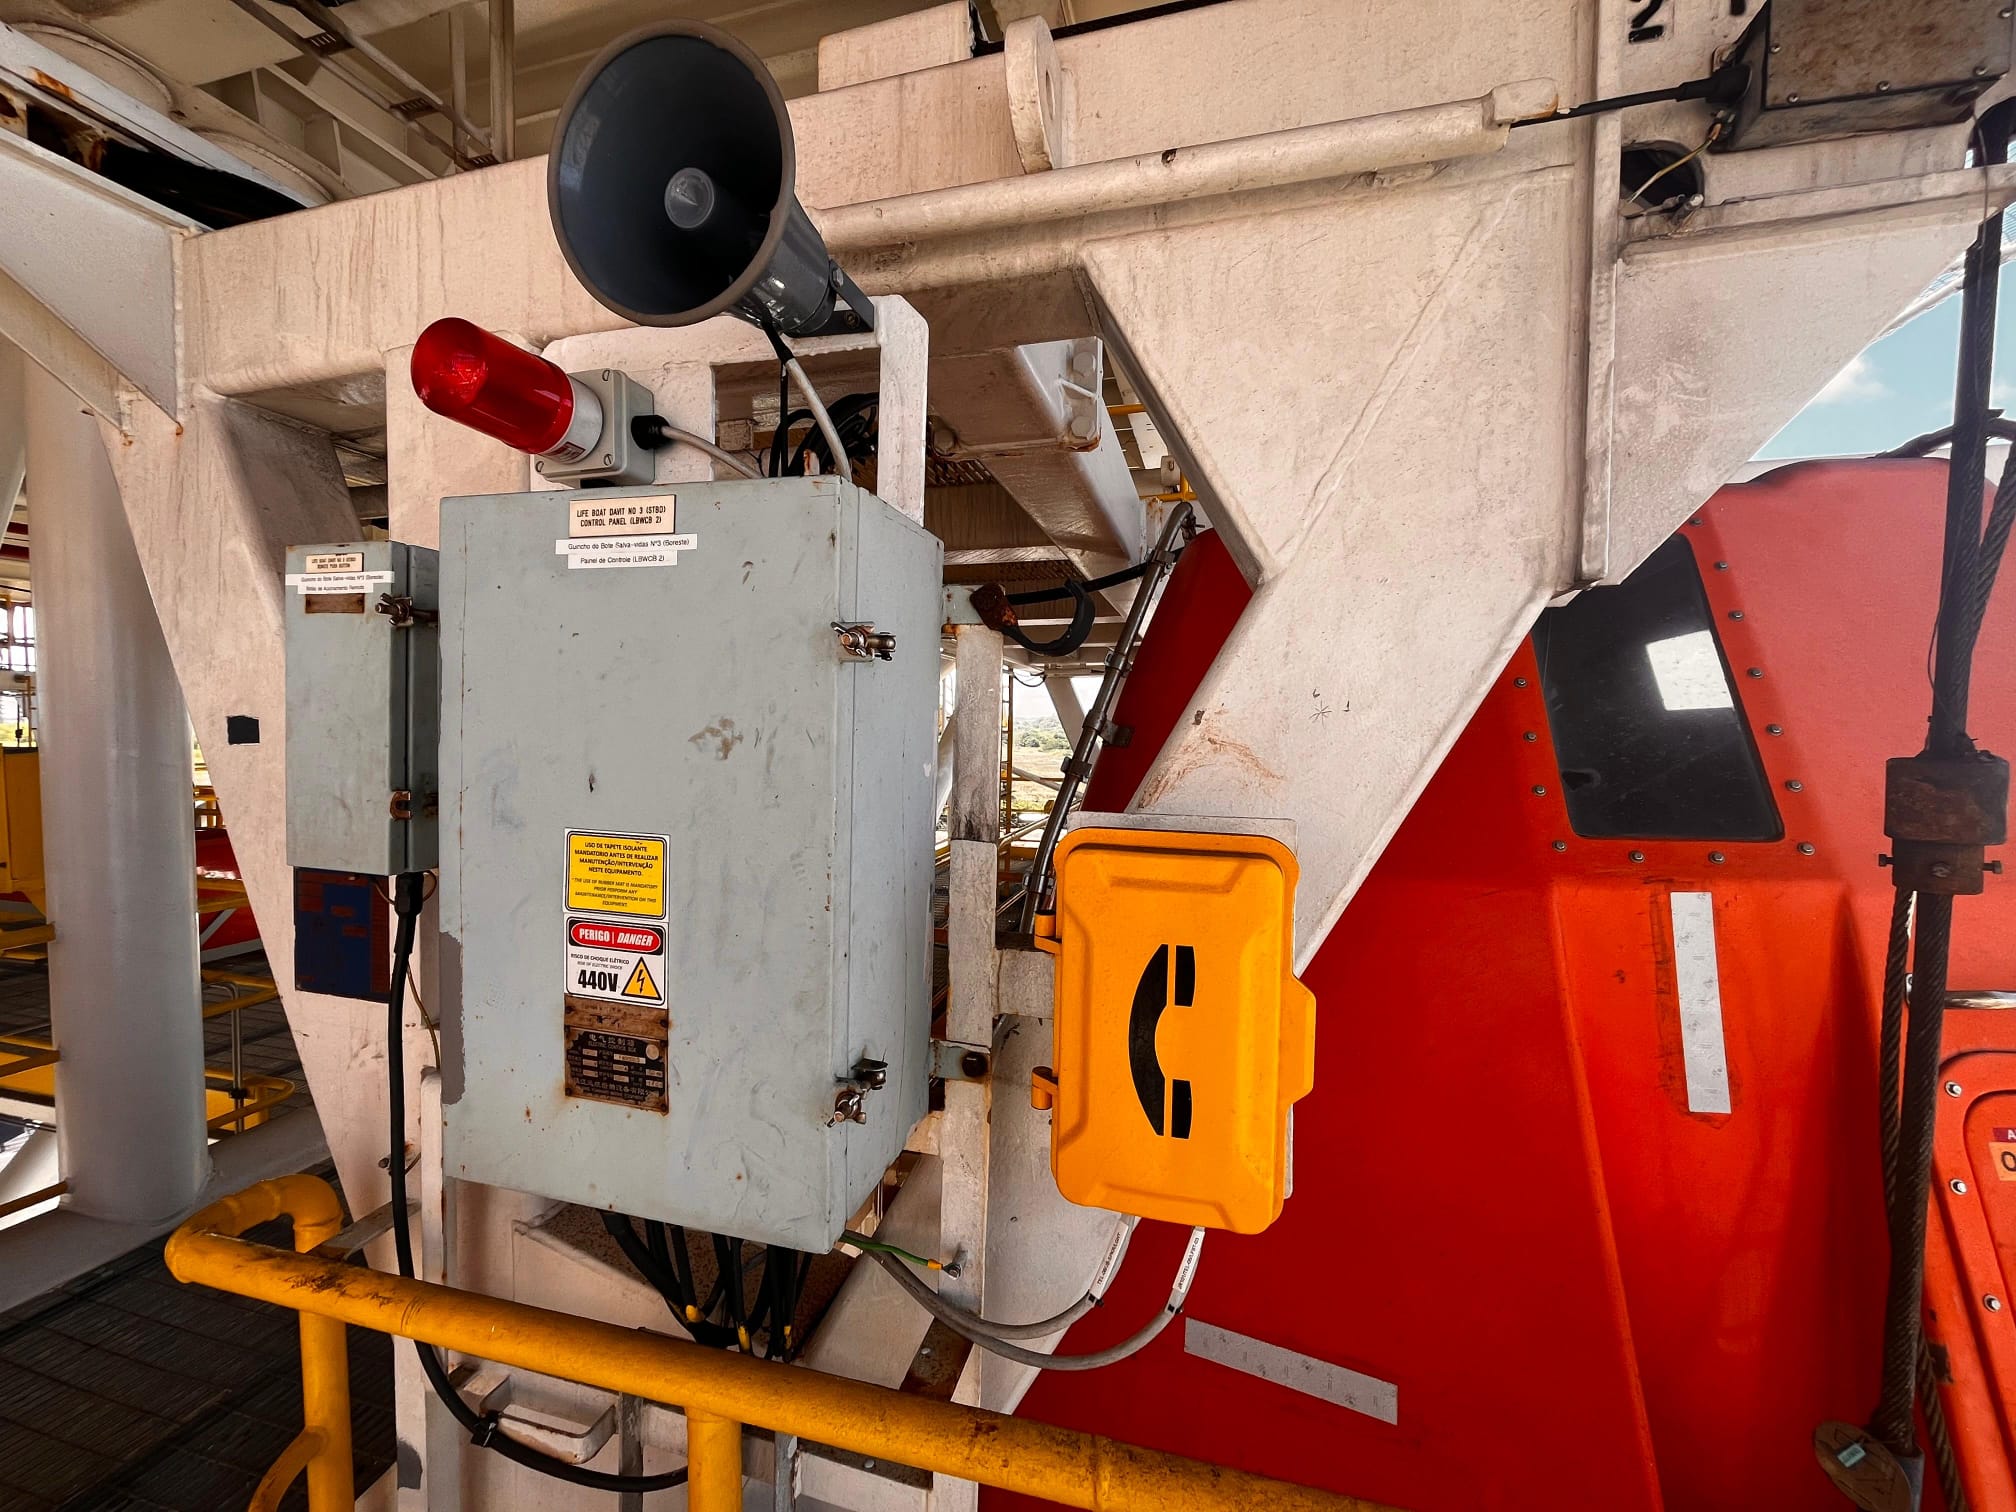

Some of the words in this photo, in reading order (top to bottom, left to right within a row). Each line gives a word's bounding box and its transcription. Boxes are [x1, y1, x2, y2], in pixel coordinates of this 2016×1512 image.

[577, 509, 589, 517] LIFE
[610, 508, 625, 516] DAVIT
[628, 507, 636, 515] NO
[646, 506, 666, 514] (STBD)
[581, 518, 605, 527] CONTROL
[609, 517, 626, 525] PANEL
[630, 516, 652, 525] (LBWCB
[656, 516, 661, 524] 2)
[663, 538, 690, 547] (Boreste)
[579, 858, 653, 869] MANUTENÇÃO/INTERVENÇÃO
[579, 928, 610, 942] PERIGO
[617, 933, 653, 946] DANGER
[578, 969, 619, 992] 440V
